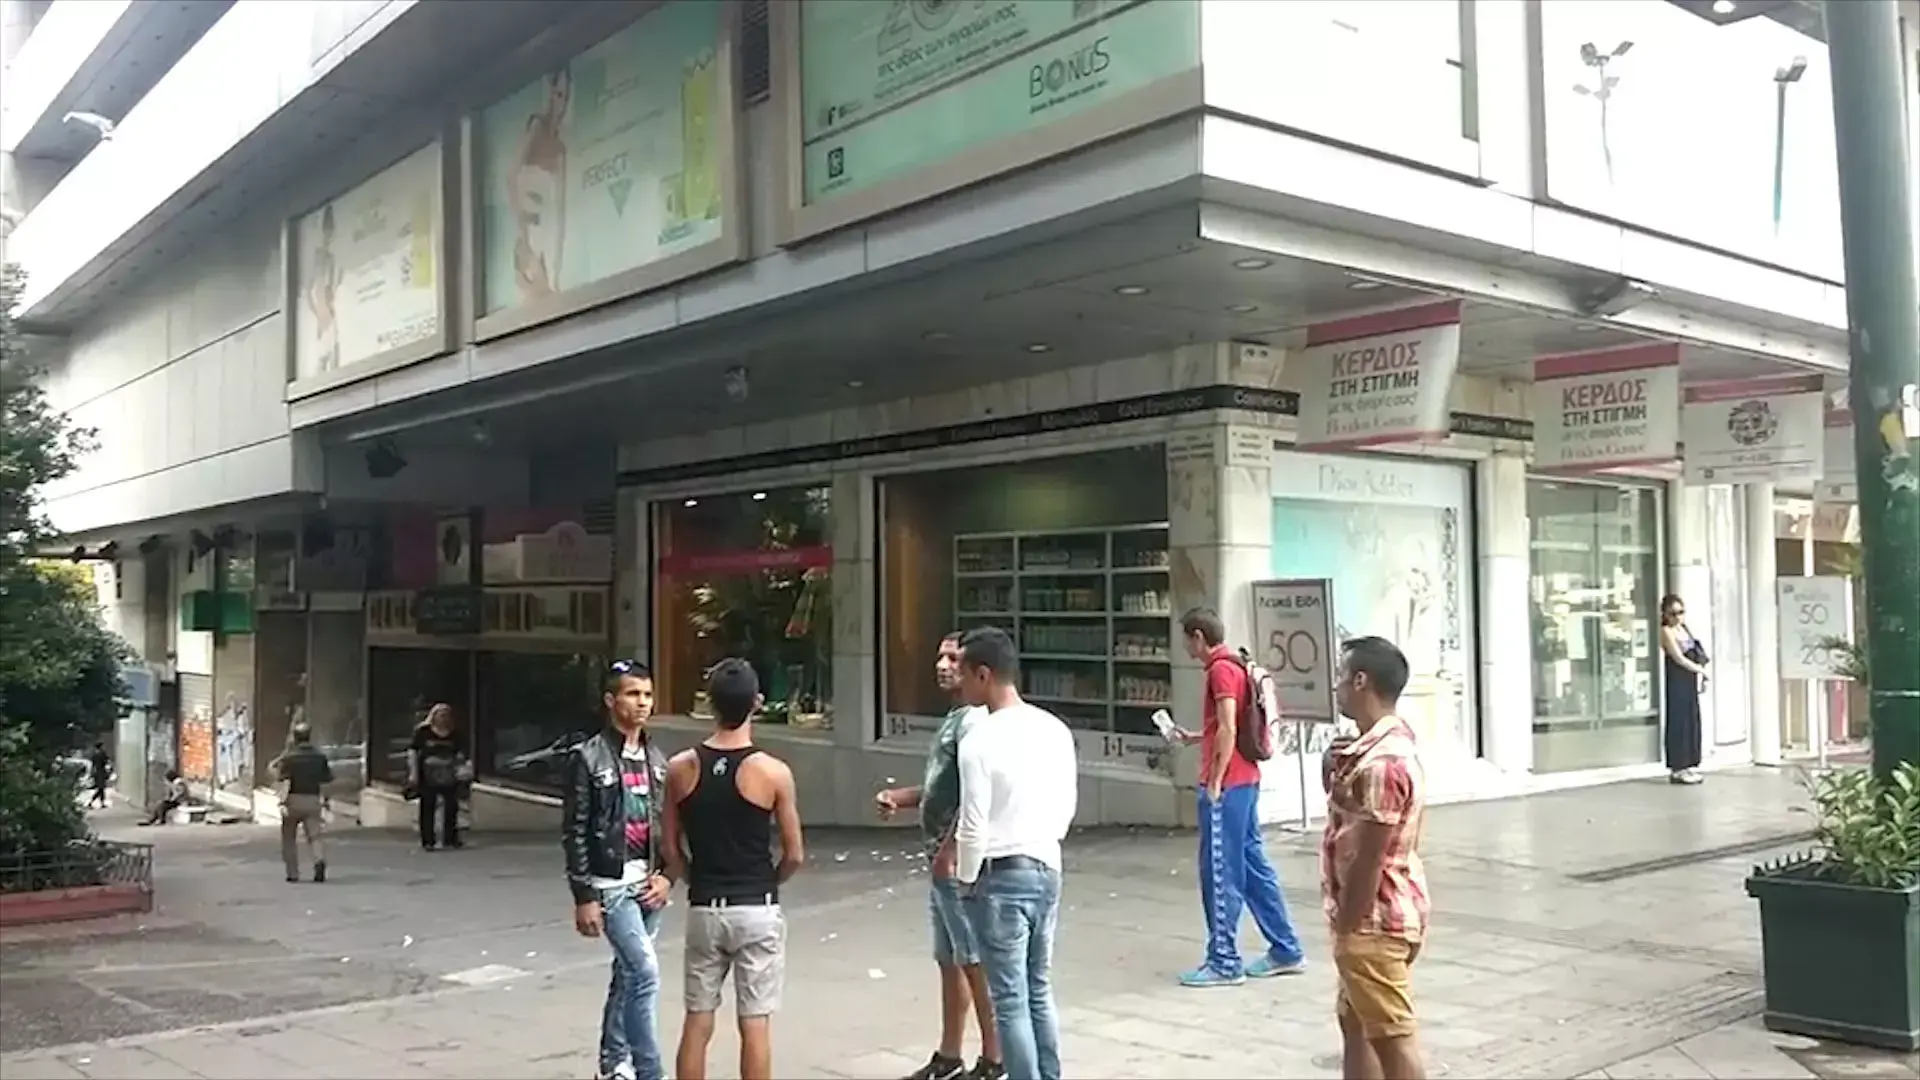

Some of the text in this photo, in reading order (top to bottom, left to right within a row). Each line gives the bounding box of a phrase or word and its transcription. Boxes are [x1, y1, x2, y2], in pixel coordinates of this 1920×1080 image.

[1029, 35, 1110, 98] BONUS
[1331, 341, 1421, 378] ΚΕΡΔΟΣ
[1329, 370, 1419, 398] ΣΤΗ ΣΤΙΓΜΗ
[1562, 379, 1647, 409] ΚΕΡΔΟΣ
[1562, 406, 1647, 428] ΣΤΗ ΣΤΙΓΜΗ
[1799, 603, 1829, 625] 50
[1266, 629, 1318, 673] 50
